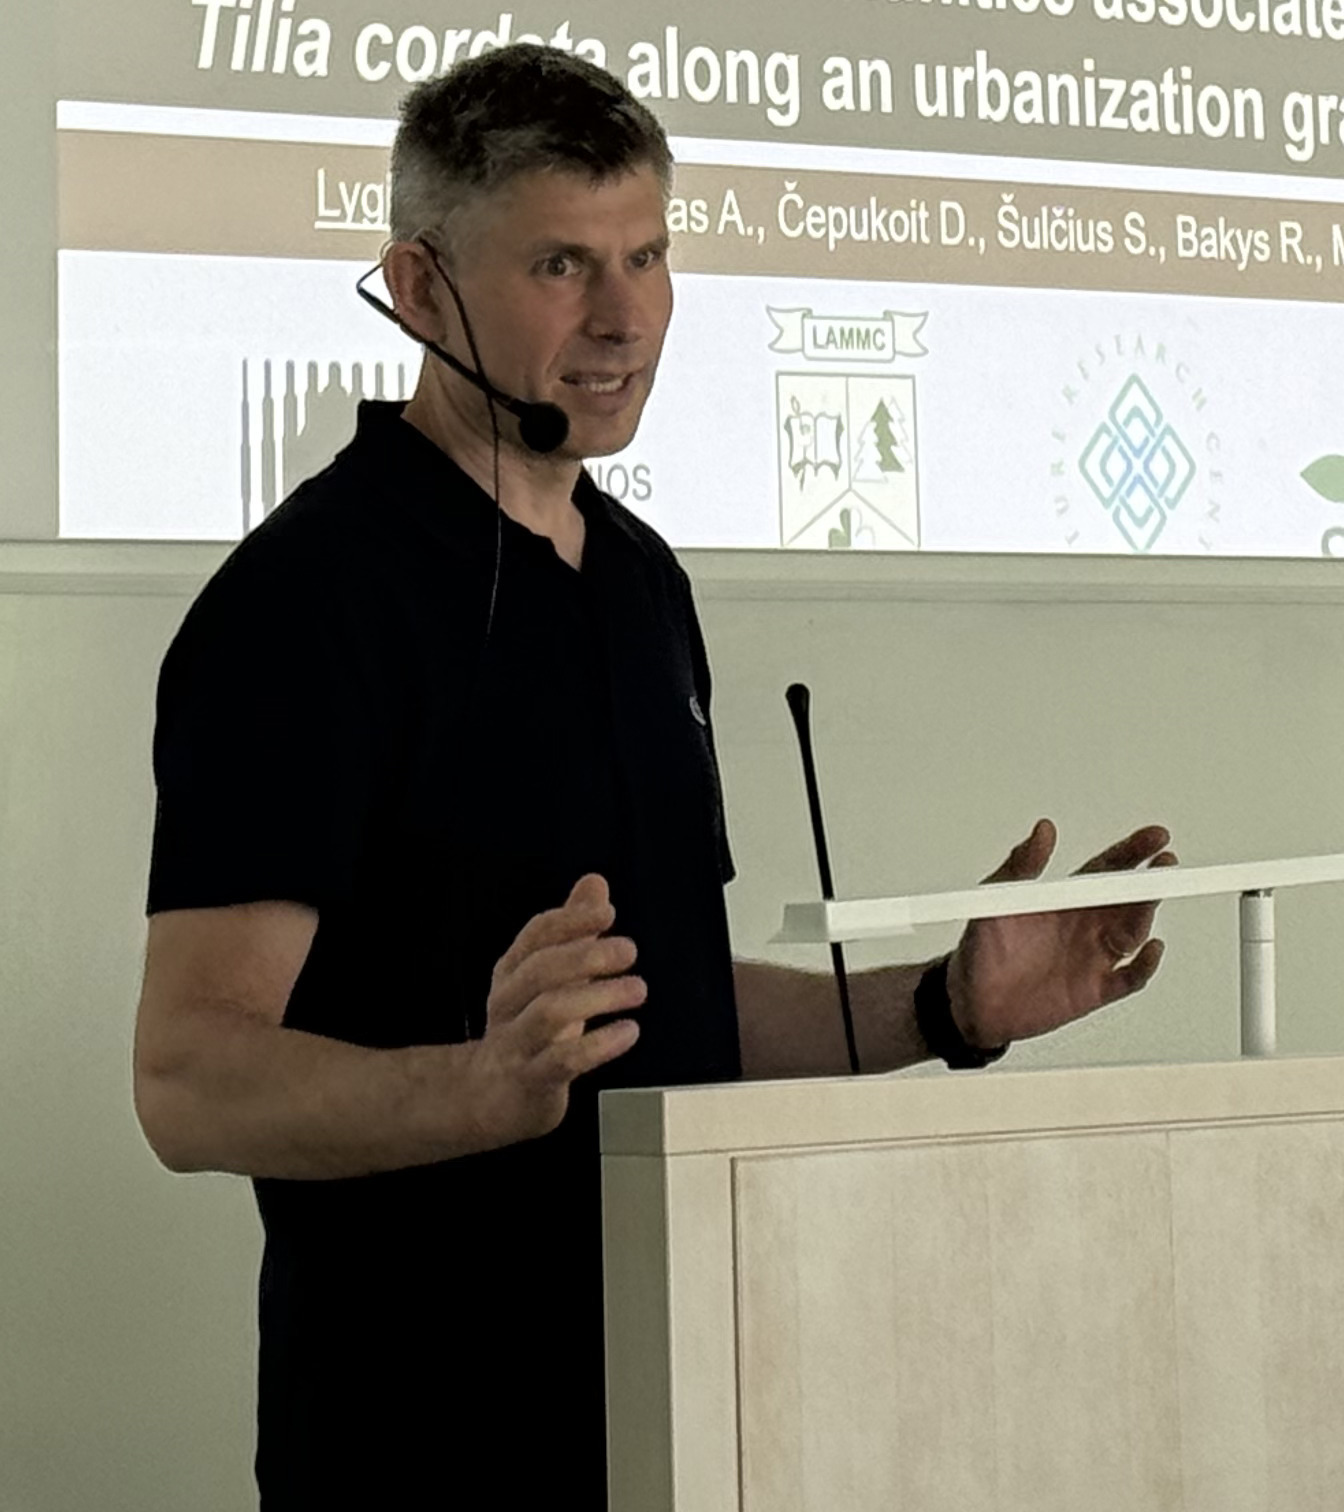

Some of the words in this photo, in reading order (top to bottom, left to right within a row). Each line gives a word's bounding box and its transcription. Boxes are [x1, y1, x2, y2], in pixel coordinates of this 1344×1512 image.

[627, 26, 799, 126] along
[822, 52, 893, 113] an
[914, 50, 1264, 140] urbanization
[666, 198, 709, 233] as
[717, 189, 765, 244] A.,
[778, 180, 930, 251] Čepukoit
[940, 200, 985, 255] D.,
[997, 193, 1114, 253] Šulčius
[1124, 211, 1165, 264] S.,
[1176, 214, 1271, 271] Bakys
[1279, 220, 1323, 273] R.,
[813, 325, 886, 351] LAMMC
